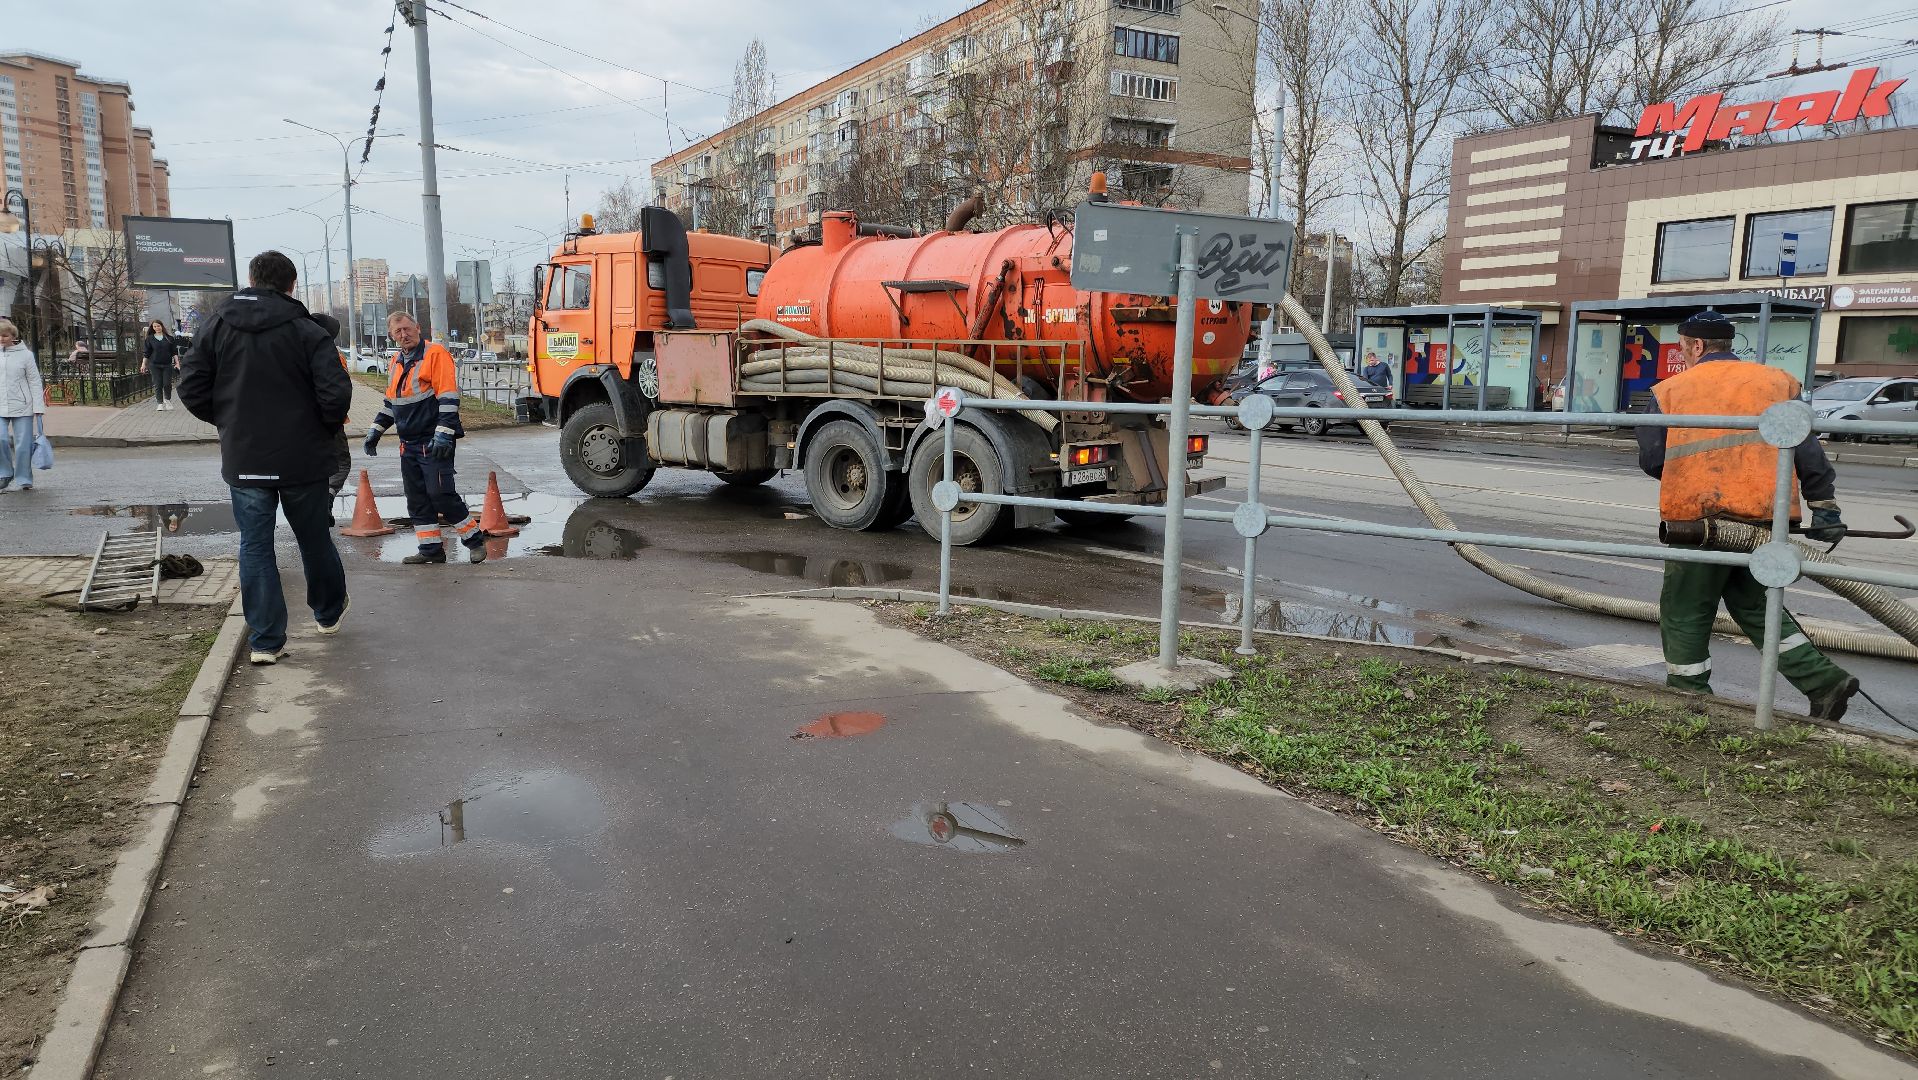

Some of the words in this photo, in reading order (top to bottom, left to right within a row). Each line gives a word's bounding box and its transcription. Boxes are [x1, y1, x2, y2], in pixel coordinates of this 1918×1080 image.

[1635, 67, 1909, 152] Маяк
[1857, 296, 1899, 304] ЖЕНСКАЯ
[1667, 363, 1687, 373] 1781
